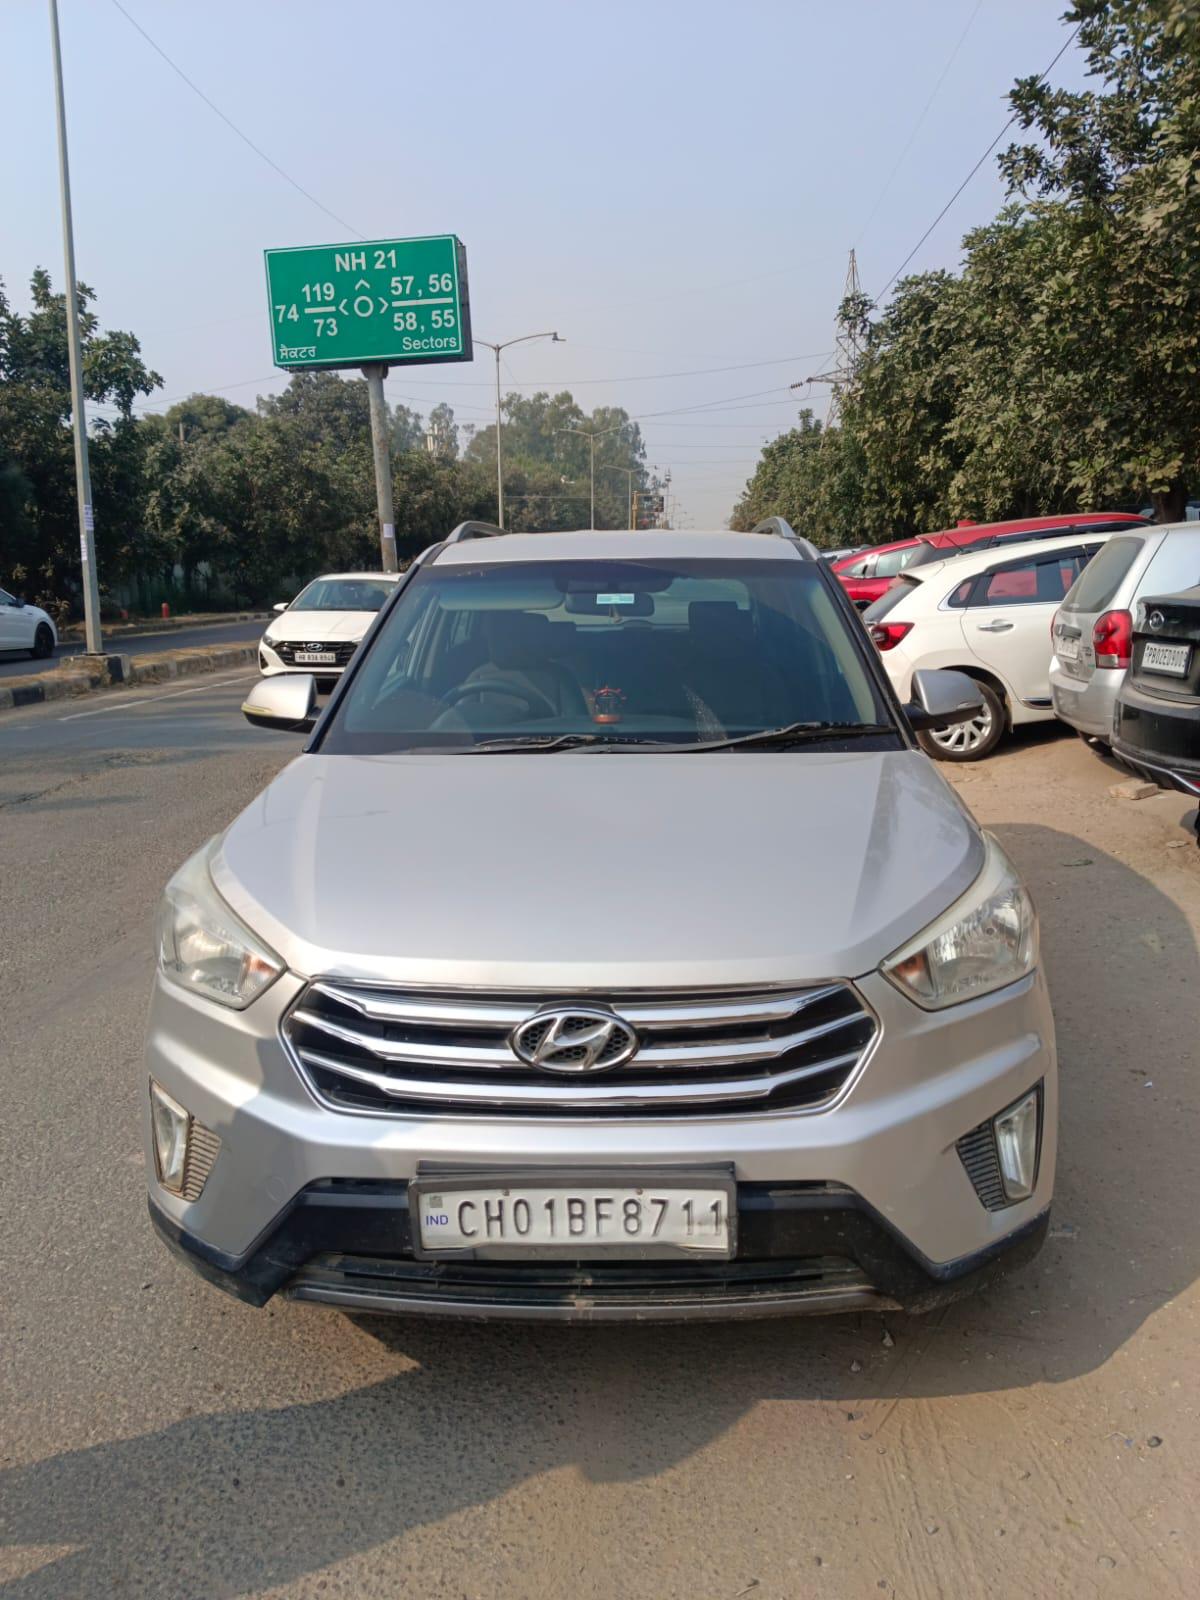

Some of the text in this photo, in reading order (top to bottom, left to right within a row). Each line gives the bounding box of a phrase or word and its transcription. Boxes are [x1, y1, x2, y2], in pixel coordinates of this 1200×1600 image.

[335, 250, 397, 272] NH 21
[301, 282, 336, 303] 119
[428, 273, 453, 293] 56
[275, 304, 300, 323] 74
[431, 309, 456, 329] 55
[313, 318, 339, 337] 73
[279, 344, 317, 360] ਸੈਕਟਰ
[402, 336, 458, 351] Sectors
[425, 1198, 722, 1238] IND CH01BF8711
